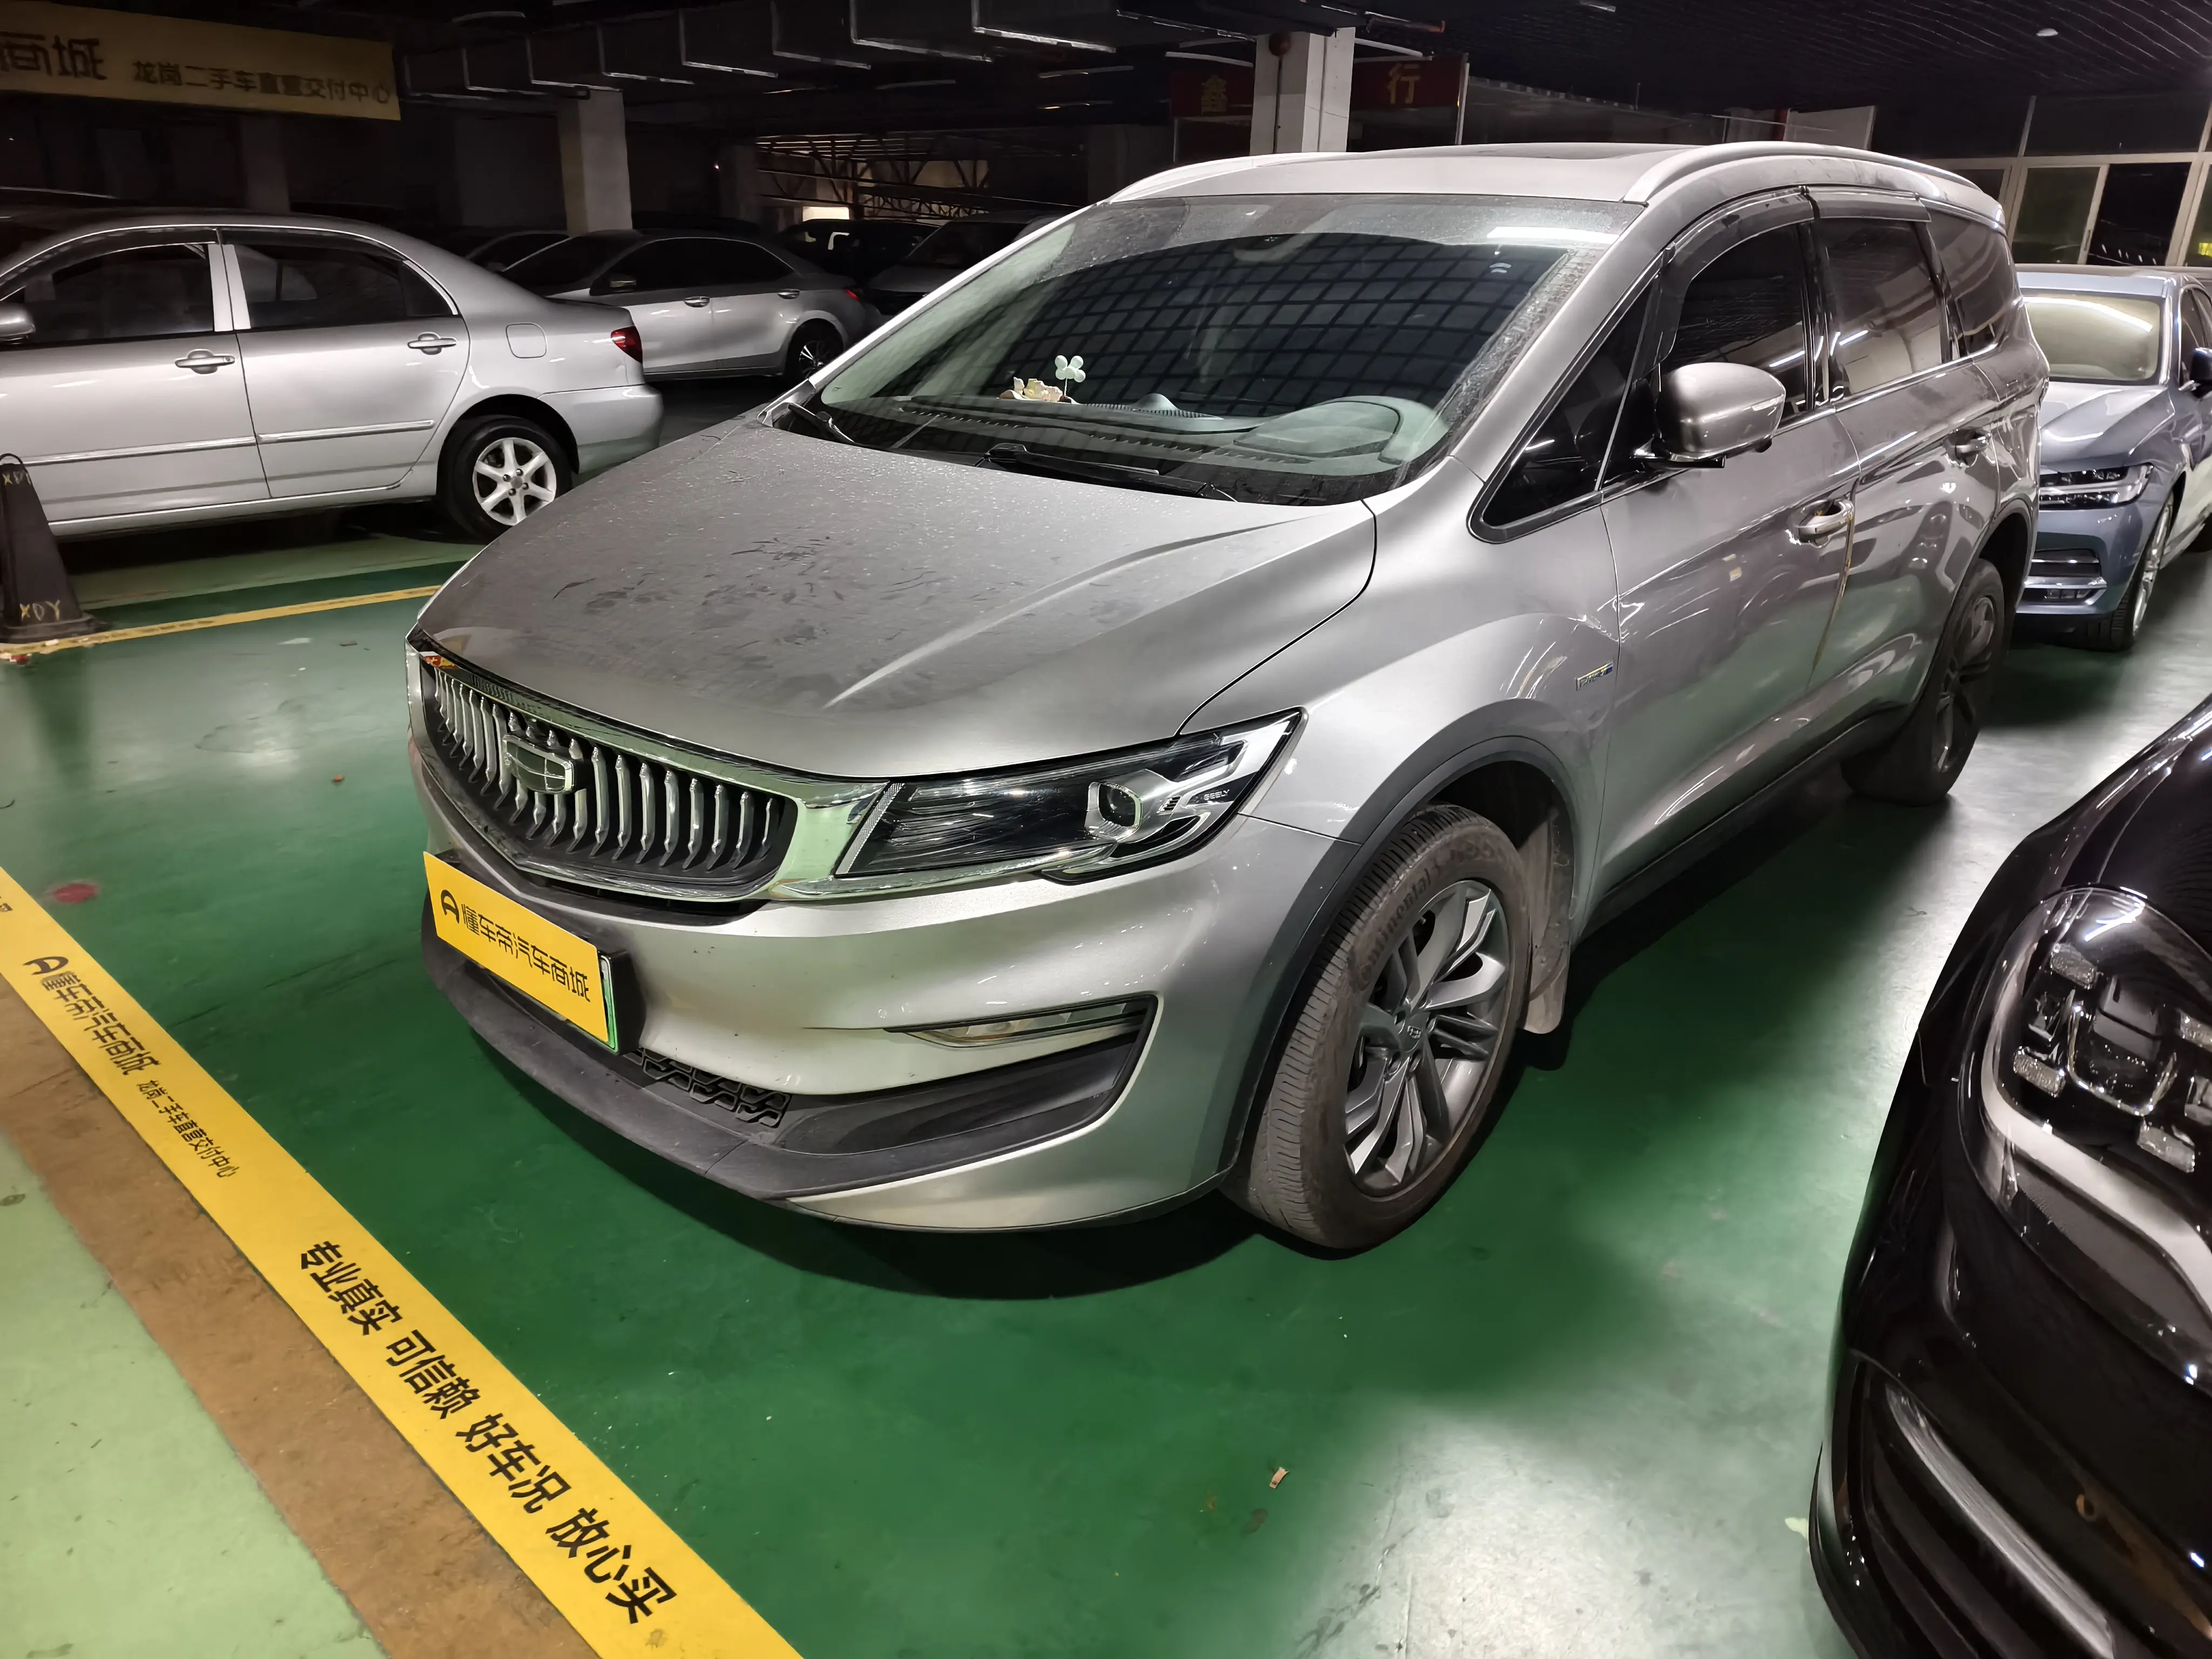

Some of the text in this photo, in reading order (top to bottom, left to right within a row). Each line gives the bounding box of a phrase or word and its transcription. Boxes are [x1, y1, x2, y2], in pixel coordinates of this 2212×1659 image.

[1386, 63, 1421, 105] 行
[19, 599, 60, 621] XDY
[1204, 789, 1230, 801] GEELY
[461, 903, 590, 1002] 懂车帝汽车商城
[42, 971, 161, 1075] 懂车帝汽车商城
[301, 1240, 677, 1624] 专业真实 可信赖 好车况 放心买
